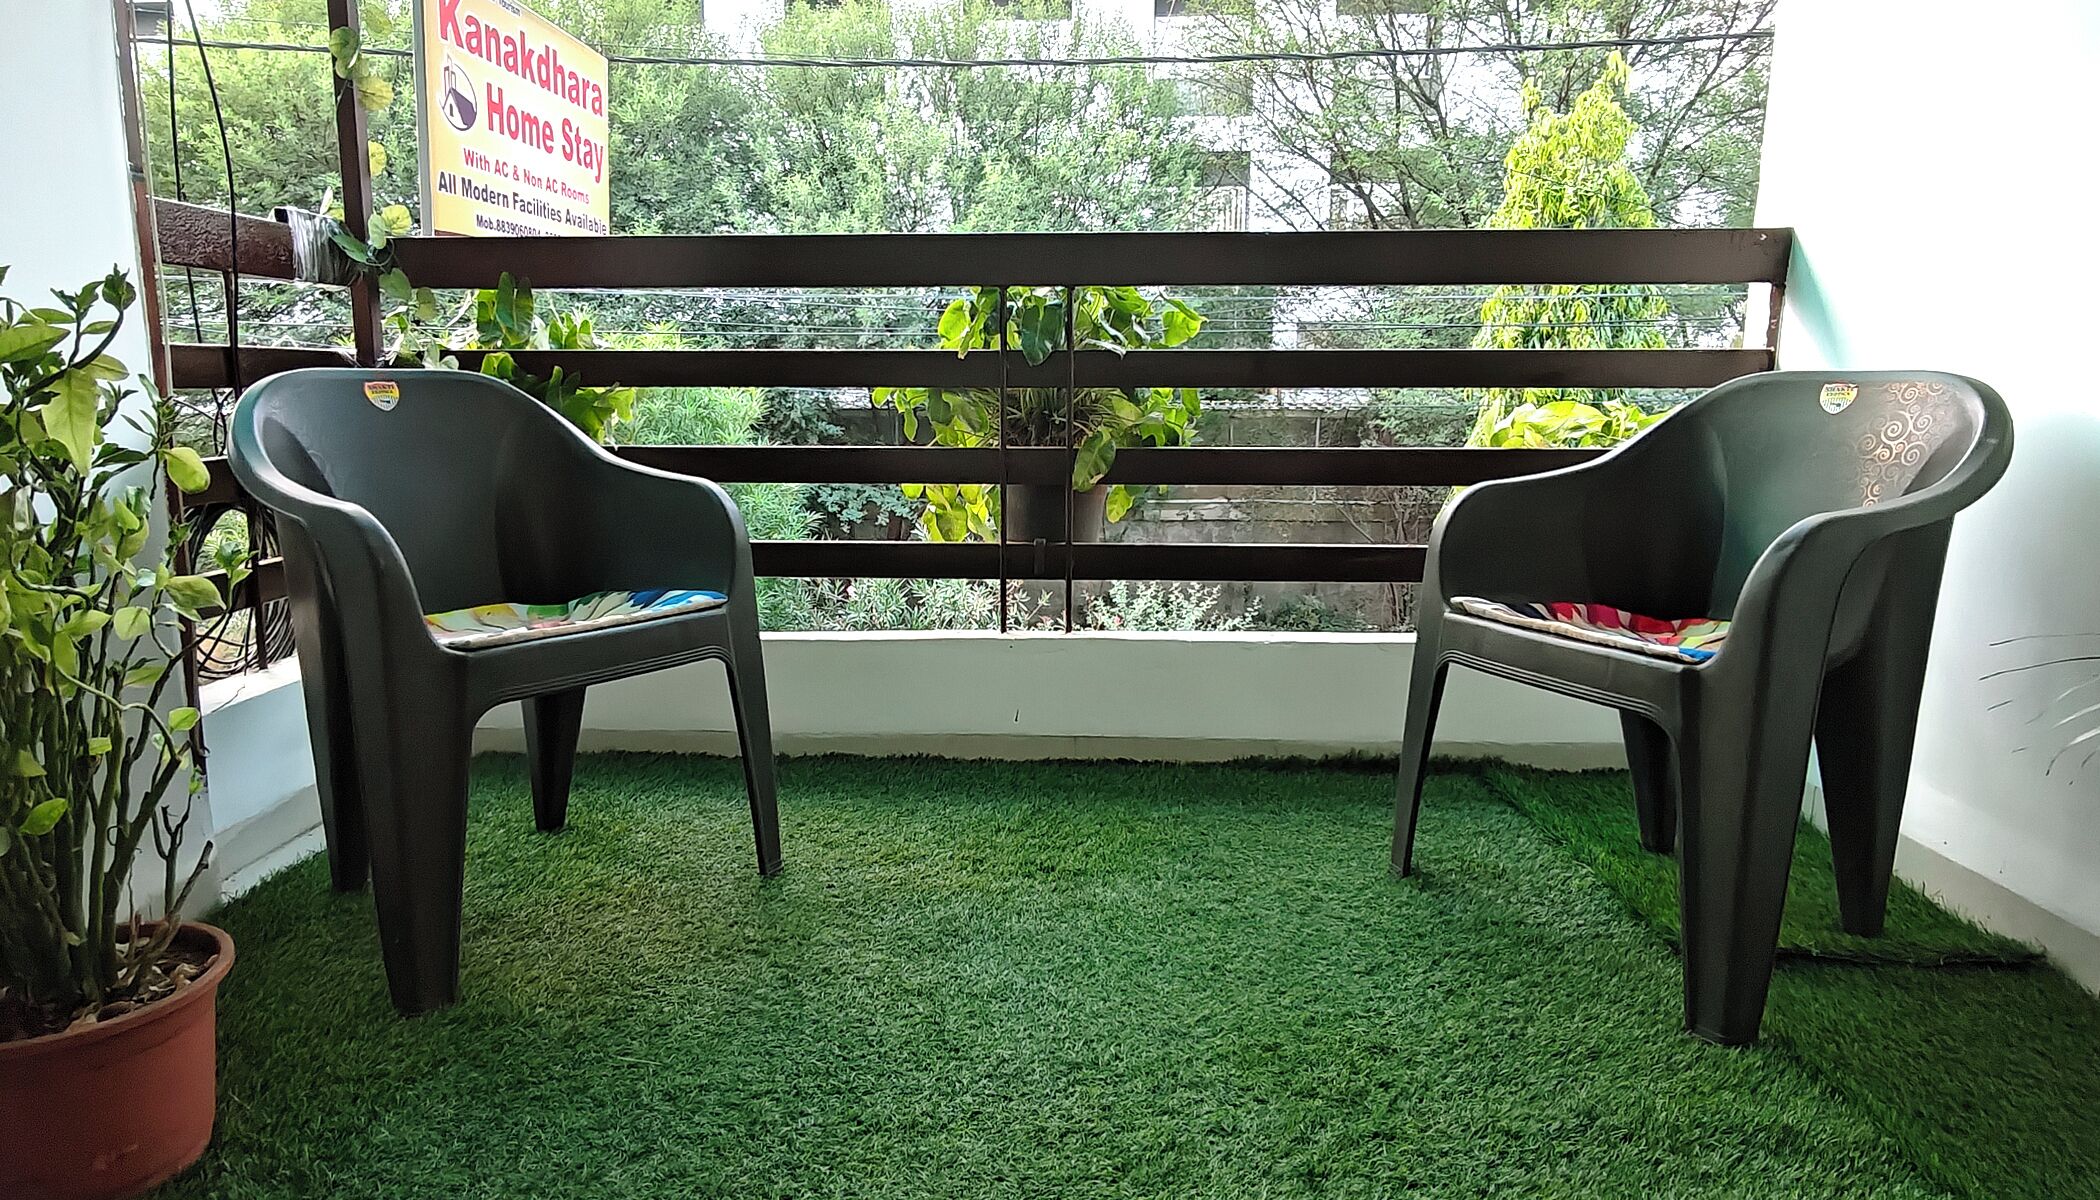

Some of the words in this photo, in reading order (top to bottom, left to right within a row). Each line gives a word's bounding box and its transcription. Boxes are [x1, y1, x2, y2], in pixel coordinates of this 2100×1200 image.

[439, 0, 603, 117] Kanakdhara
[487, 82, 554, 153] Home
[562, 118, 603, 183] Stay
[438, 172, 456, 194] All
[461, 177, 509, 208] Modern
[513, 192, 562, 222] Facilities
[565, 209, 607, 235] Available
[464, 148, 490, 172] With
[494, 160, 508, 177] AC
[513, 165, 519, 181] &
[524, 169, 542, 189] Non
[546, 177, 558, 193] AC
[562, 182, 589, 204] Rooms
